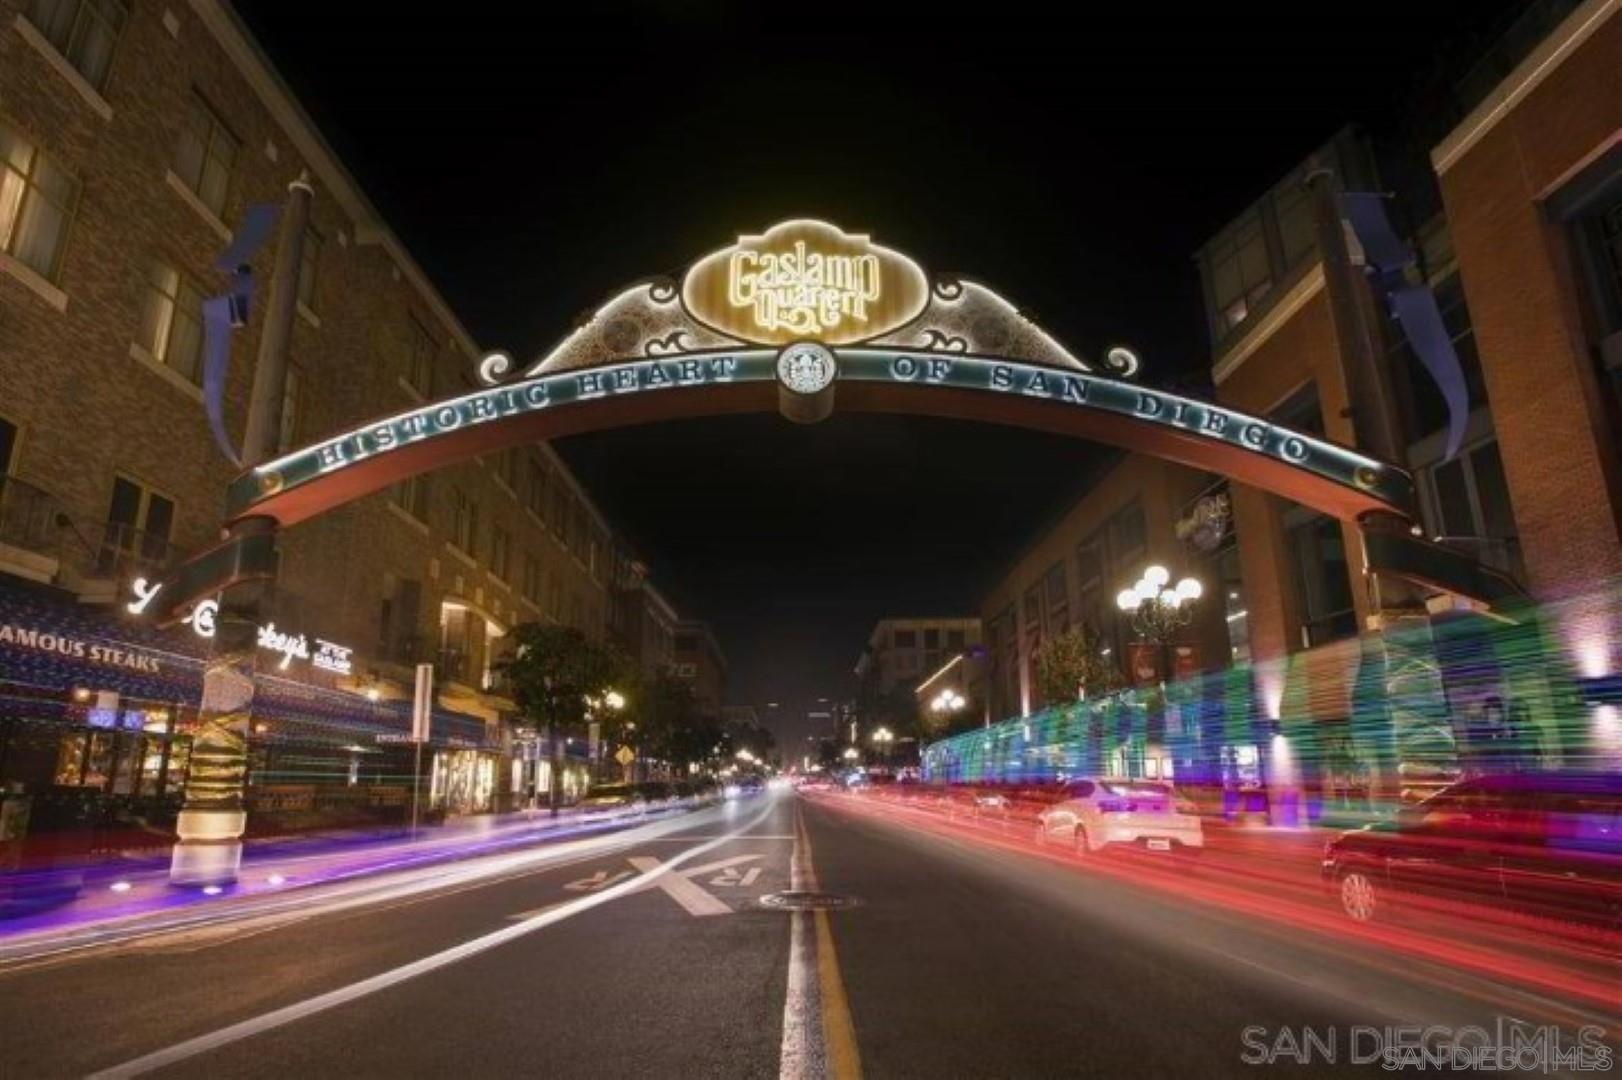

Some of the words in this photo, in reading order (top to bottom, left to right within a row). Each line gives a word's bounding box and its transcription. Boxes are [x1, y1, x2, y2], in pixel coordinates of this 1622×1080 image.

[730, 241, 880, 307] Gaslamp
[754, 286, 869, 335] Quarter
[317, 382, 551, 473] HISTORIC
[577, 357, 739, 399] HEART
[889, 355, 953, 382] OF
[990, 364, 1089, 403] SAN
[1135, 392, 1311, 464] DIEGO
[0, 625, 85, 657] AMOUS
[89, 644, 160, 673] STEAKS
